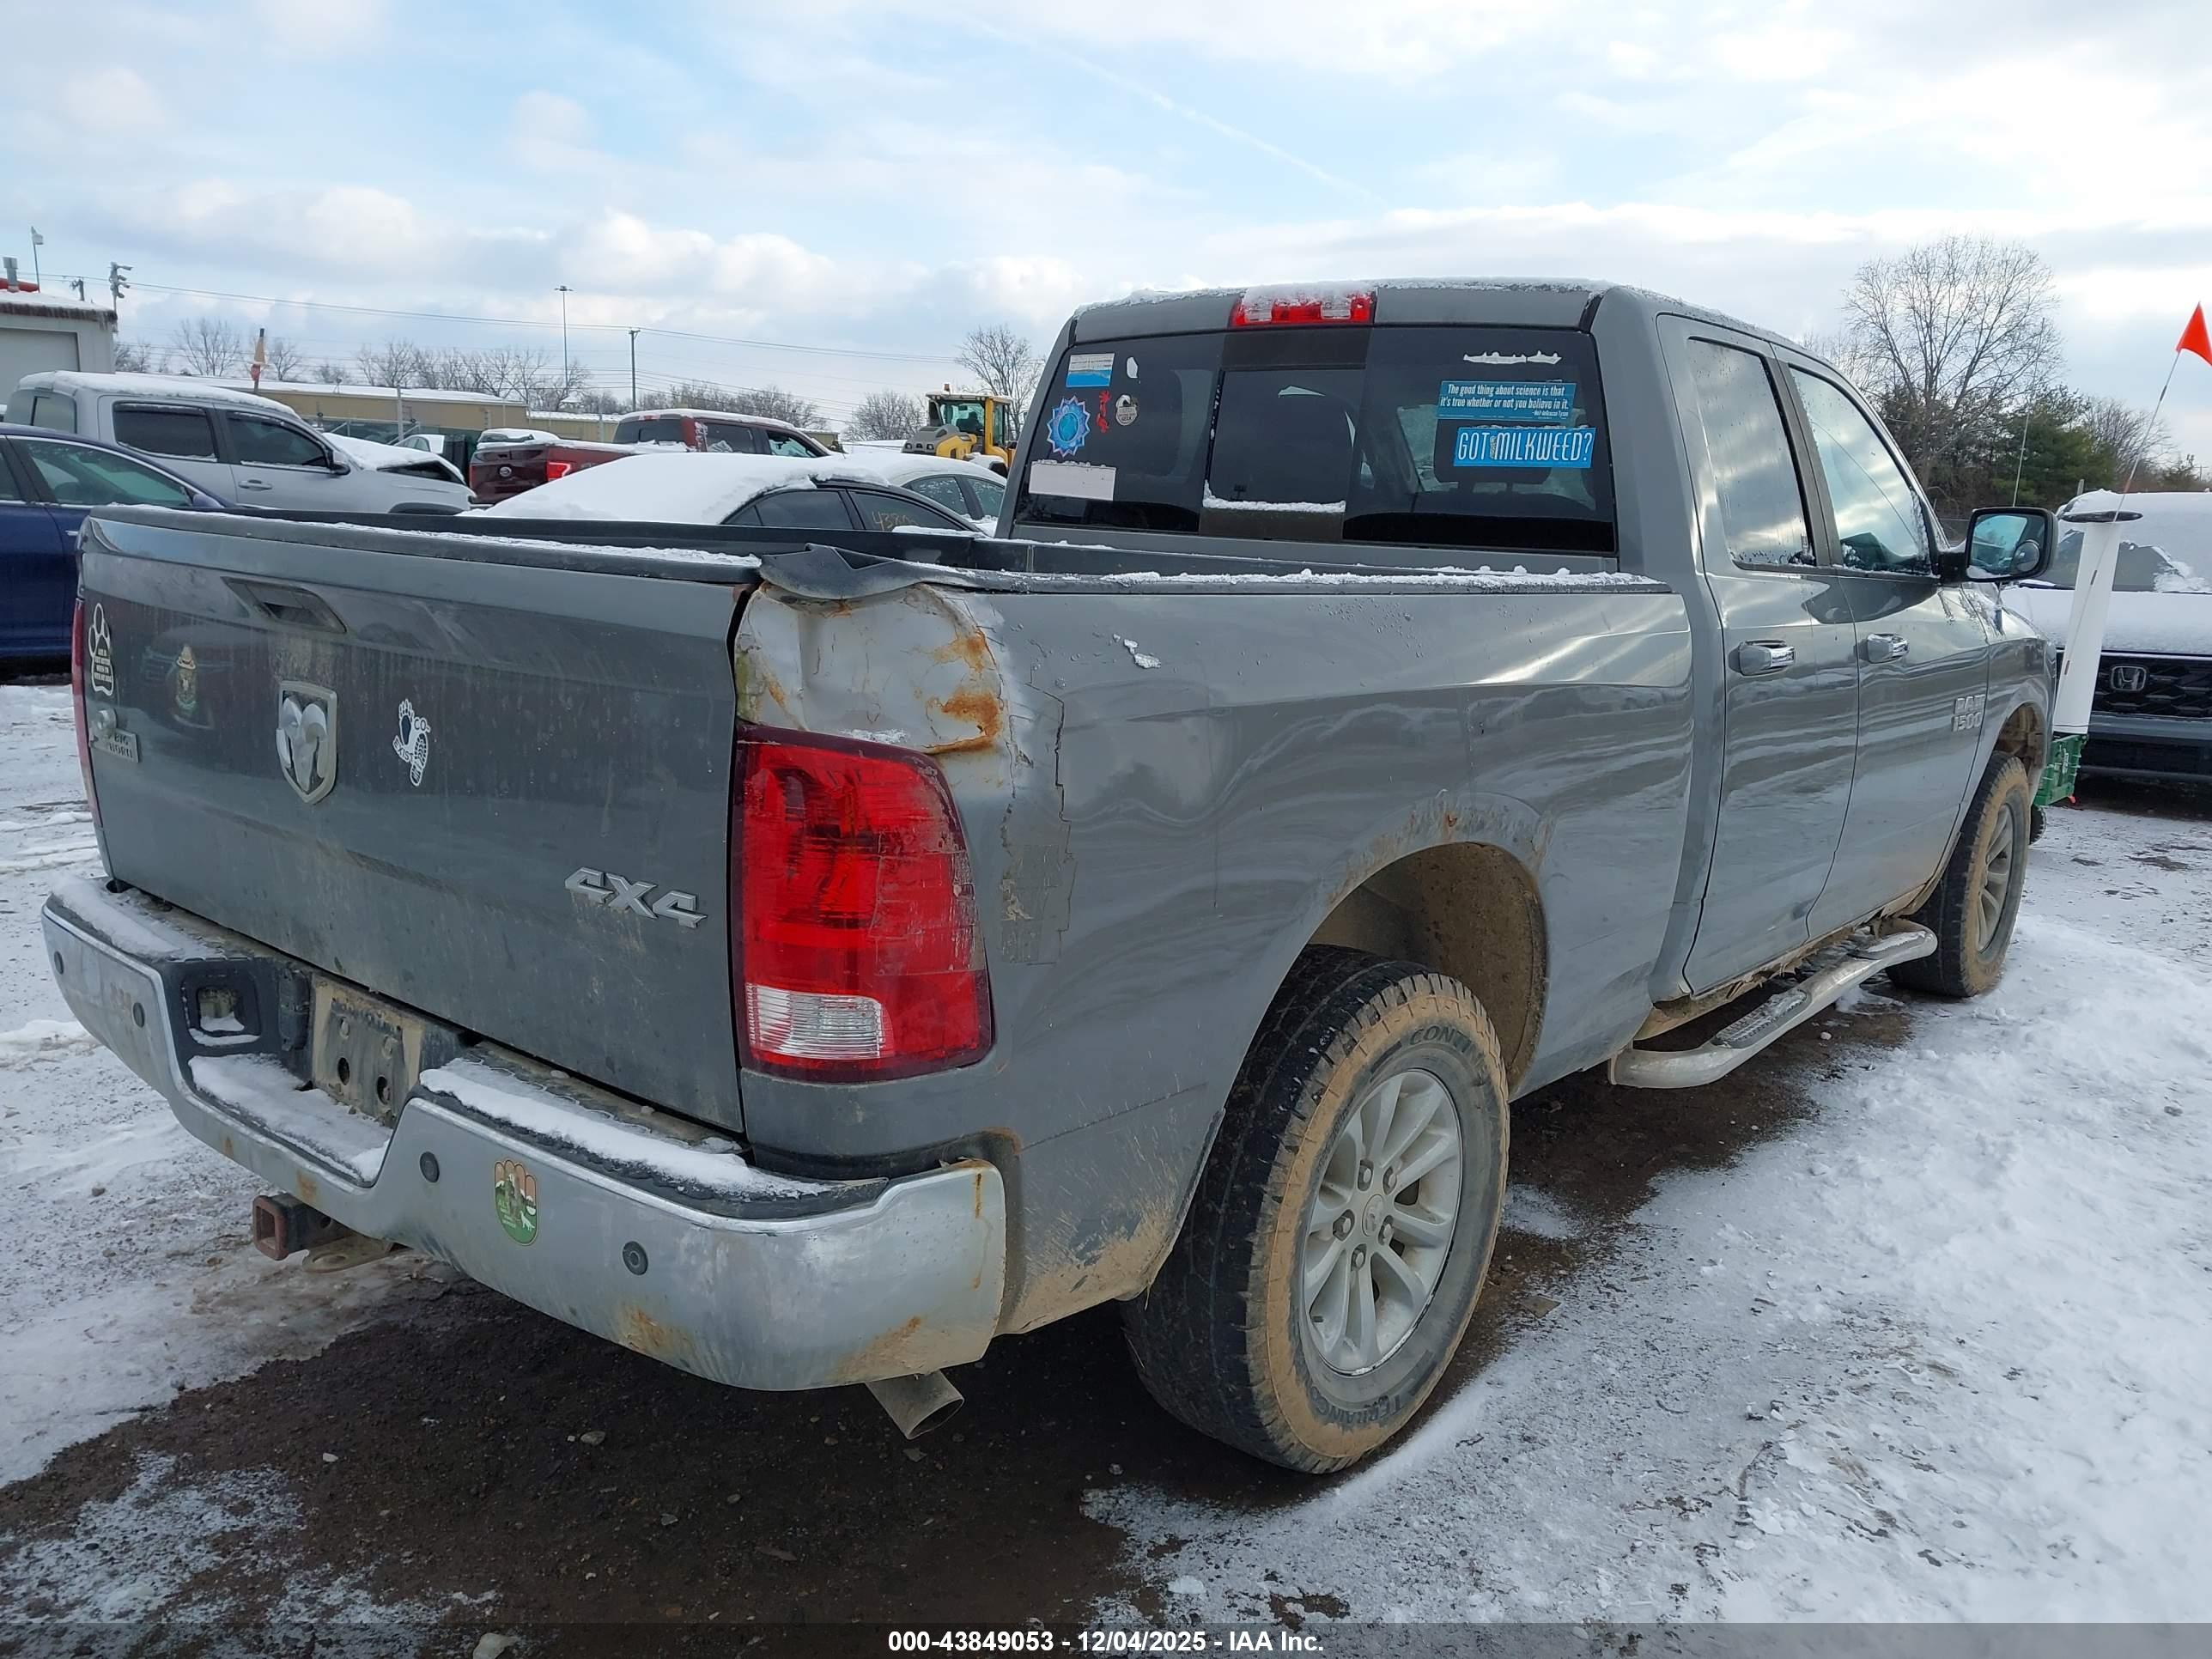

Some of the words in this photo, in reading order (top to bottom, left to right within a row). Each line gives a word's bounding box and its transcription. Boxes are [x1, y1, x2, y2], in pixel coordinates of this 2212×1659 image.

[1448, 384, 1460, 394] The
[1460, 384, 1476, 397] good
[1477, 384, 1495, 398] thing
[1495, 385, 1515, 395] about
[1515, 385, 1541, 396] science
[1542, 385, 1549, 396] is
[1550, 385, 1565, 396] that
[1440, 396, 1451, 407] it's
[1451, 397, 1466, 407] true
[1467, 397, 1493, 408] whether
[1494, 398, 1502, 408] or
[1502, 398, 1515, 409] not
[1514, 398, 1528, 411] you
[1528, 398, 1553, 409] believe
[1553, 398, 1560, 409] in
[1457, 432, 1491, 460] GOT
[1493, 432, 1593, 461] MILKWEED?
[1954, 694, 1986, 714] RAM
[1952, 712, 1983, 732] 1500
